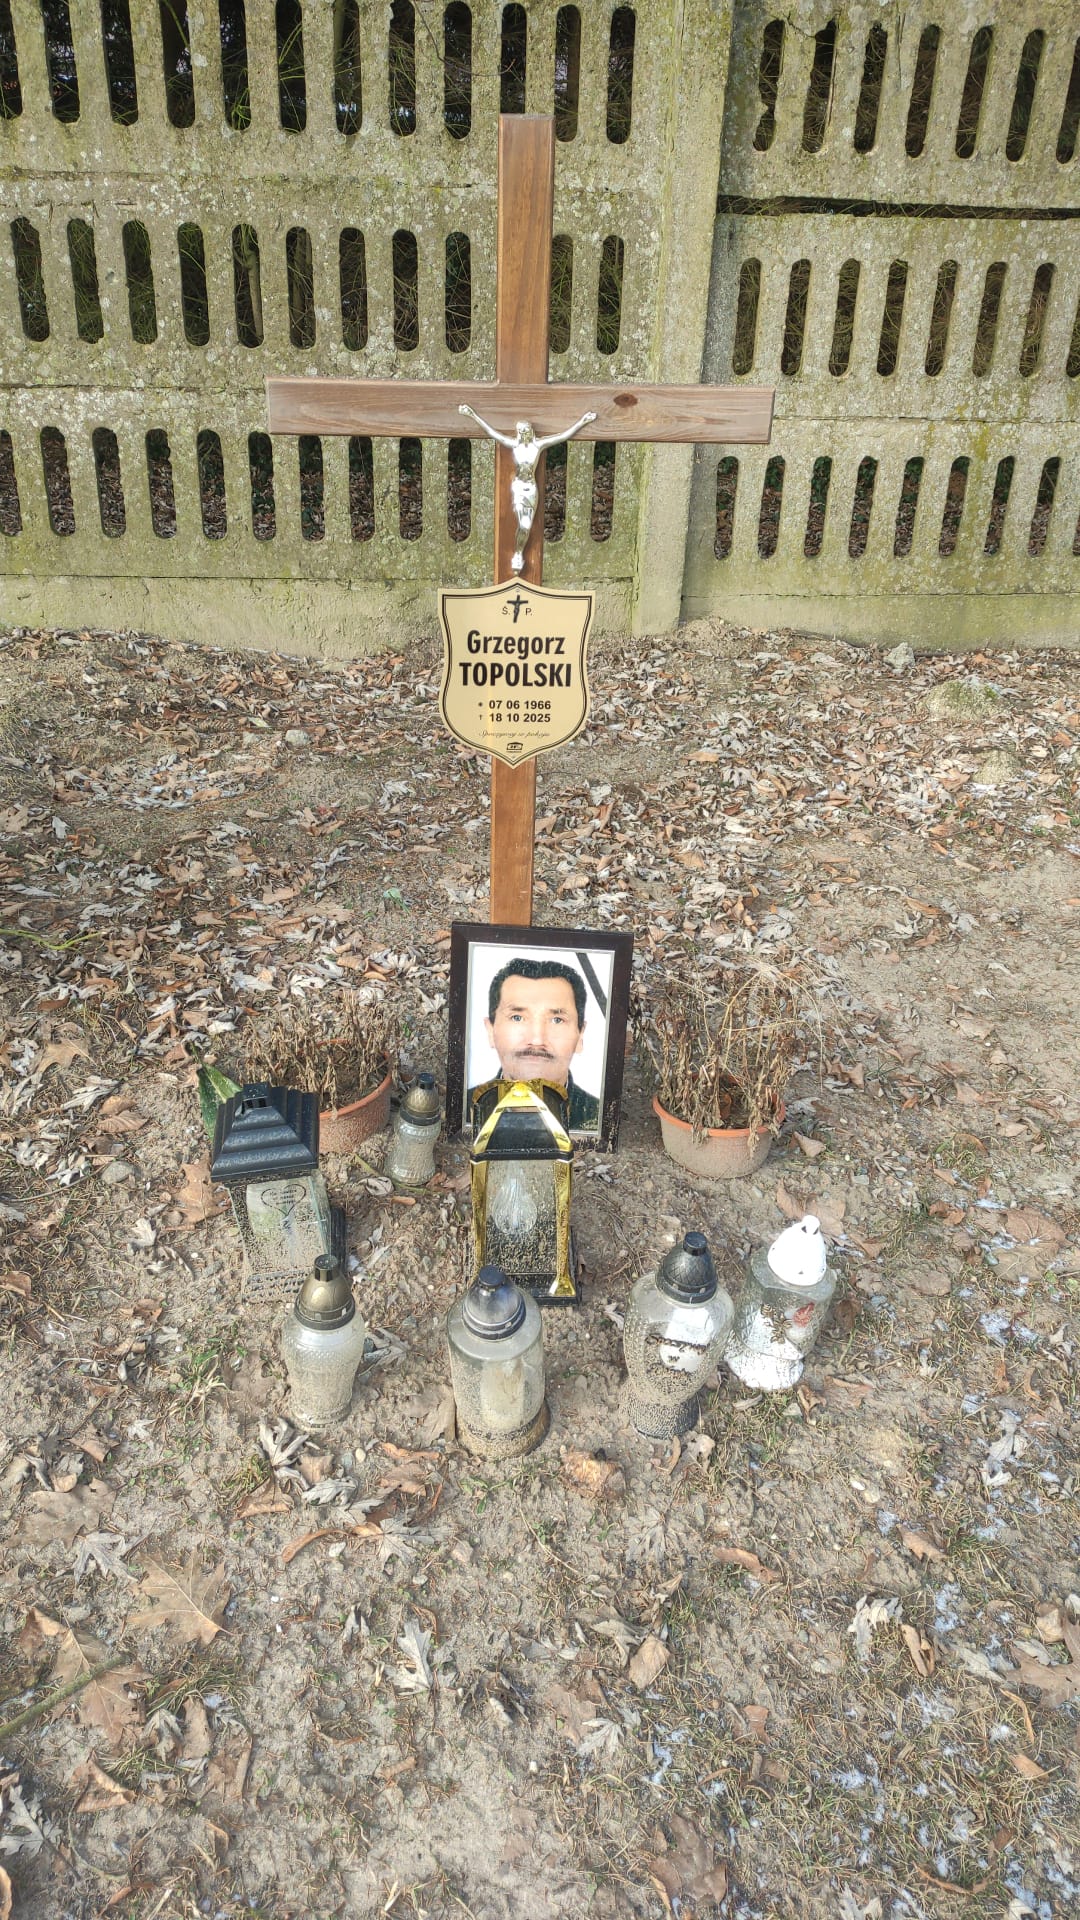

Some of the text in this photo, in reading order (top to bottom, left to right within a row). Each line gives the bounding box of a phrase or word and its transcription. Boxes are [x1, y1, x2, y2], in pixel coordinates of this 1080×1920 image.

[525, 607, 533, 616] P.
[467, 629, 565, 660] Grzegorz
[459, 662, 572, 687] TOPOLSKI
[488, 699, 551, 710] 07 06 1966
[489, 712, 551, 723] 18 10 2025
